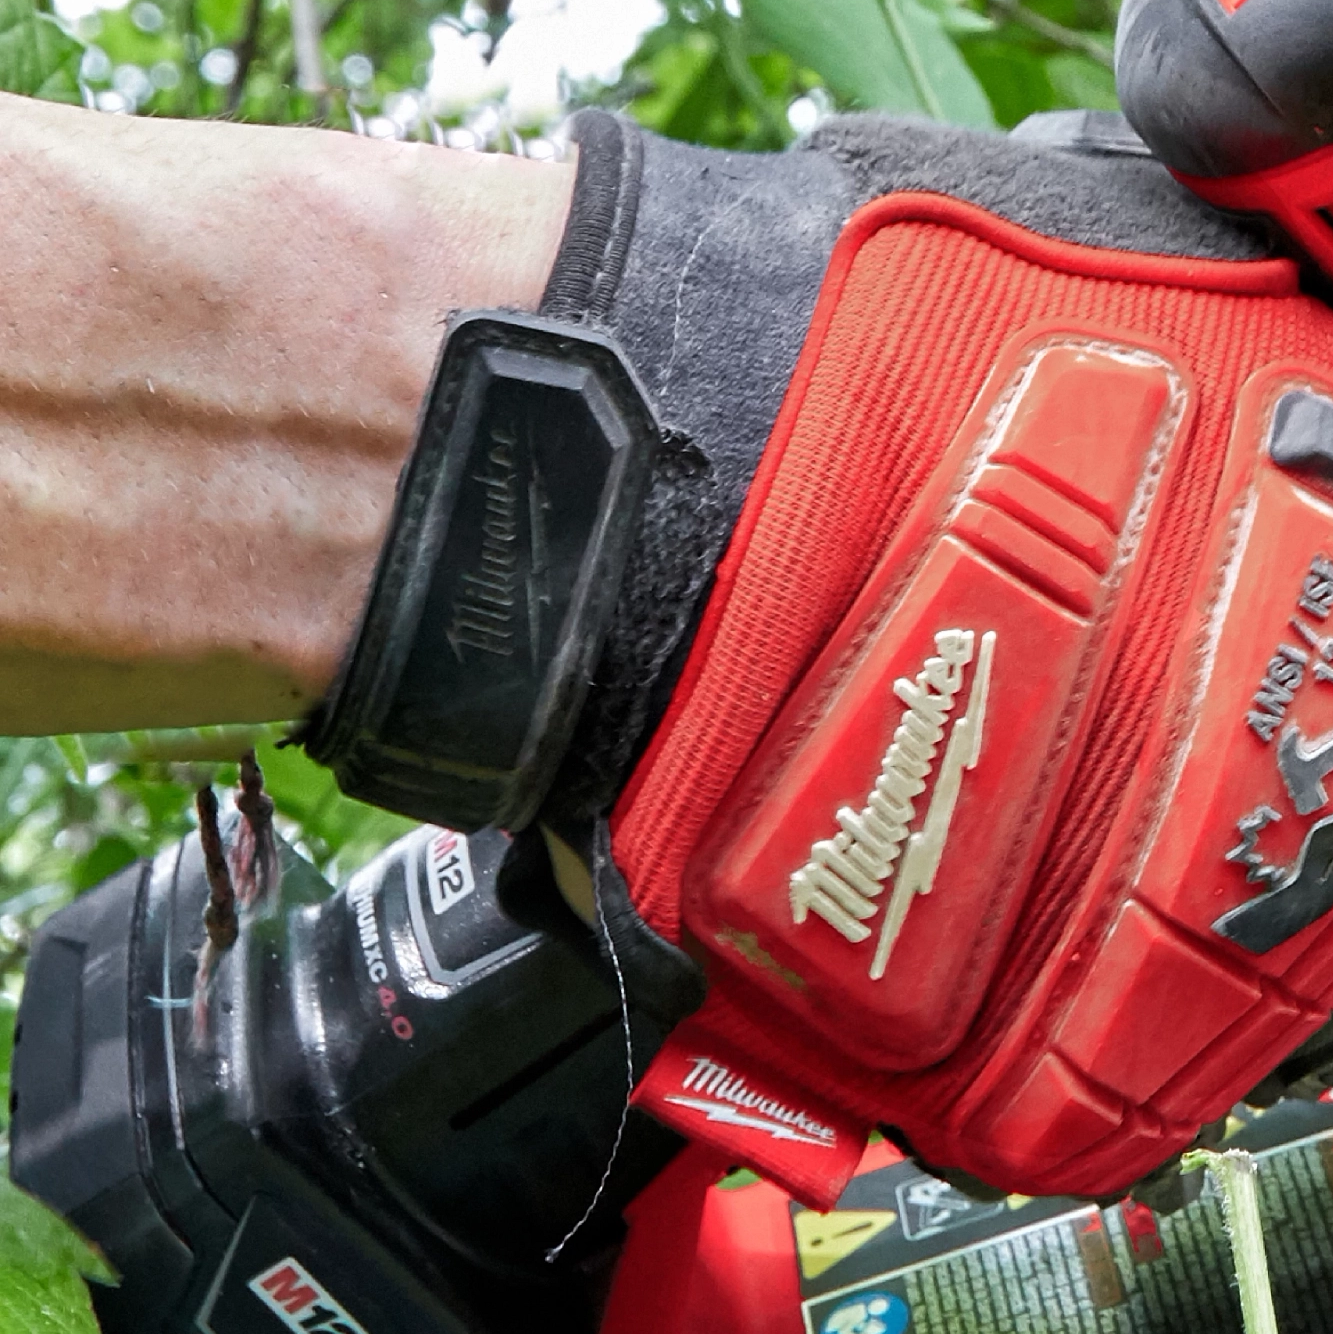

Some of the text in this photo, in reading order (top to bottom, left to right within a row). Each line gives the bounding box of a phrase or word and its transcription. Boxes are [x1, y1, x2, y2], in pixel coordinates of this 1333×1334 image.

[788, 629, 975, 944] Milwaukee
[434, 829, 465, 900] M12
[682, 1054, 836, 1139] Milwaukee
